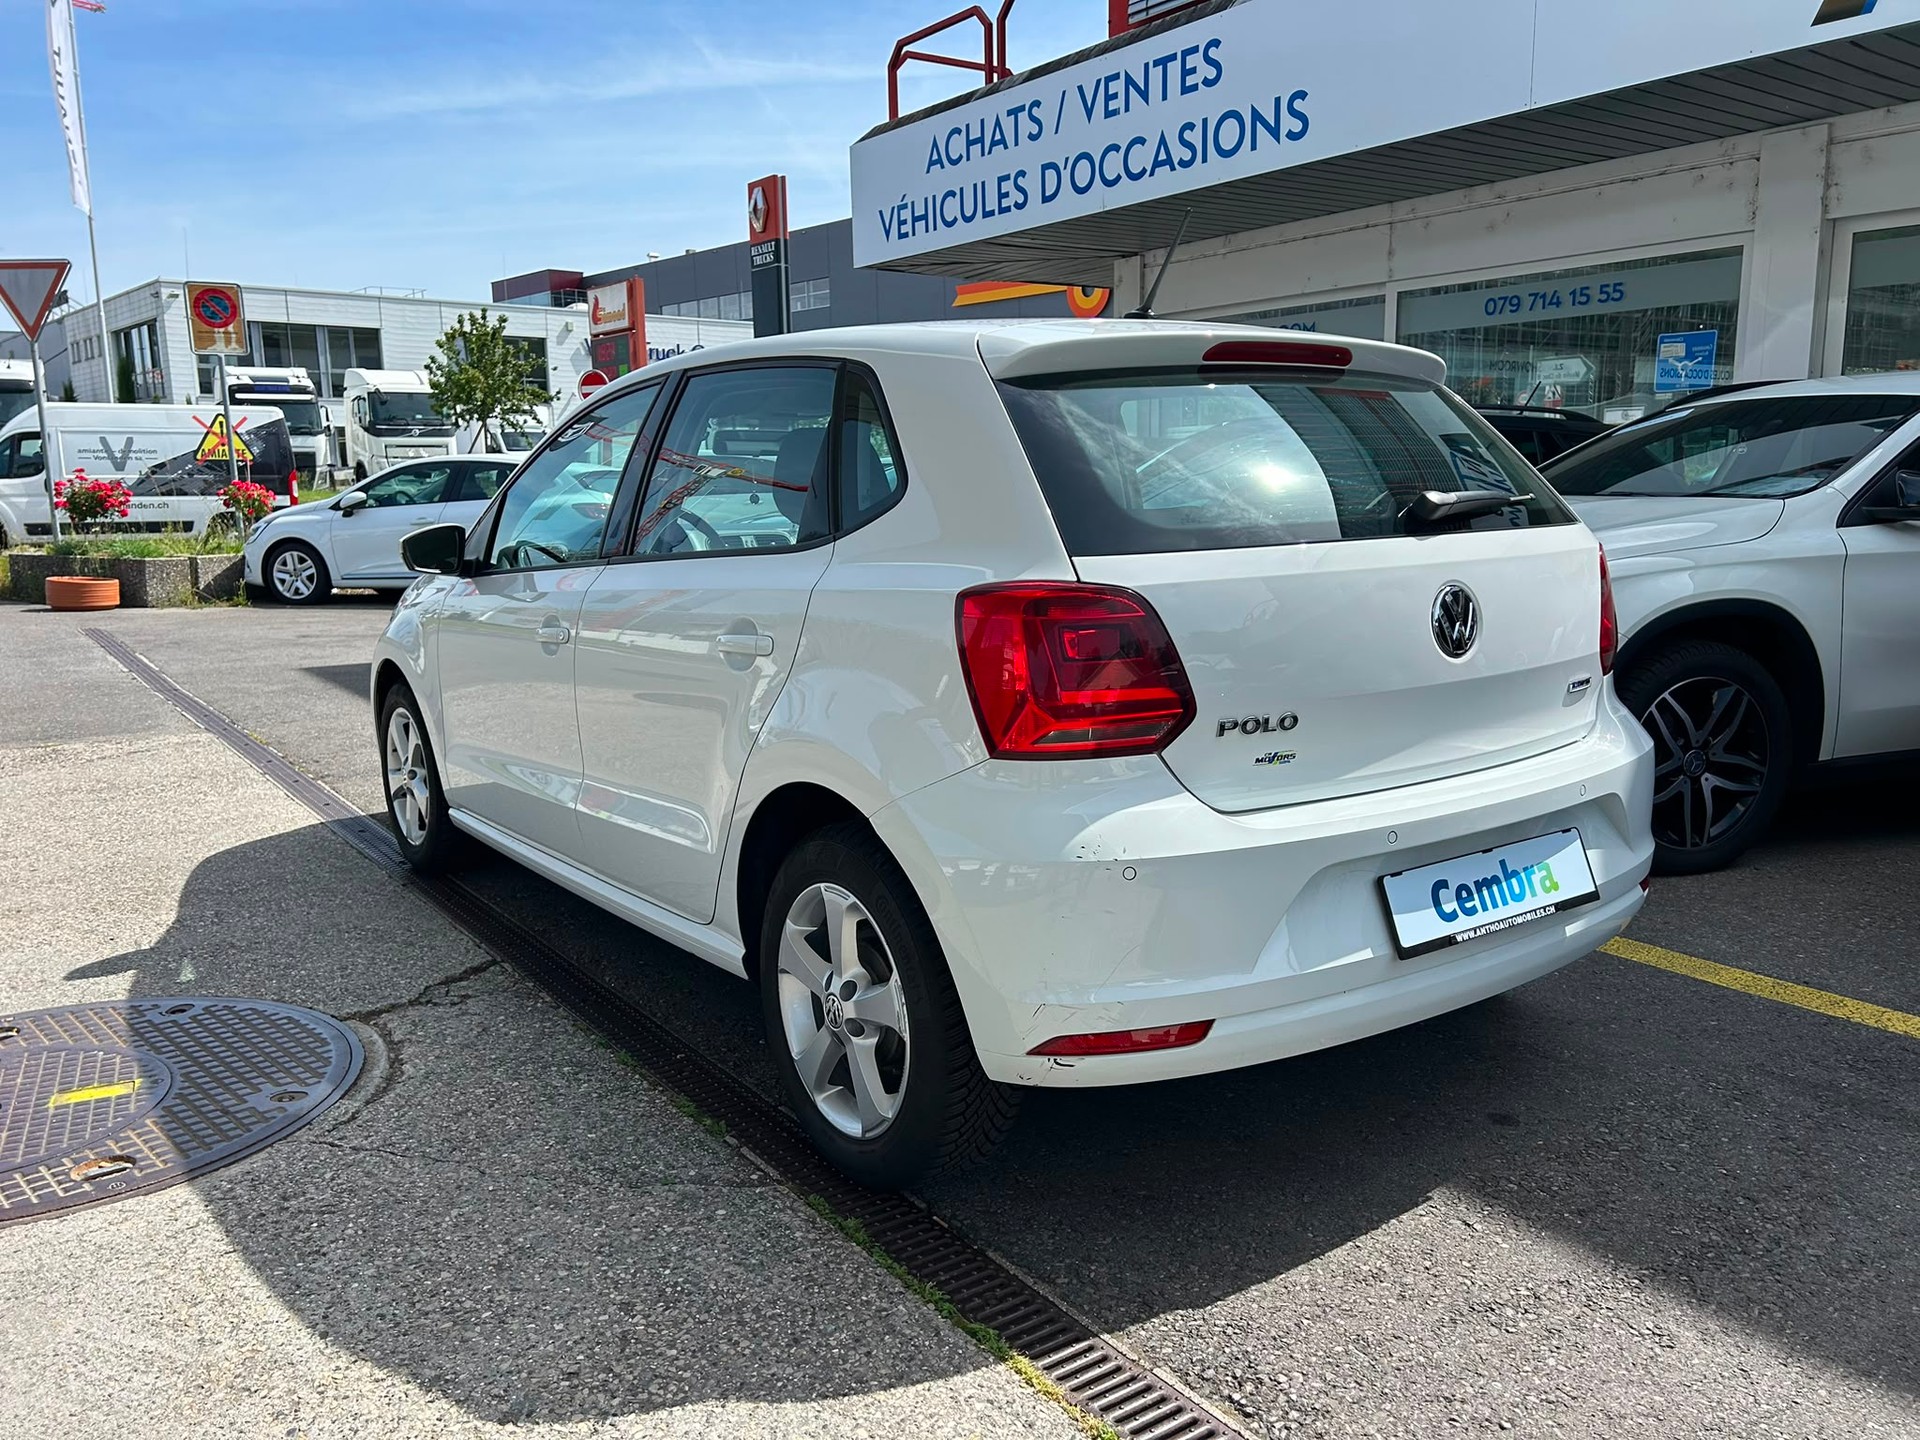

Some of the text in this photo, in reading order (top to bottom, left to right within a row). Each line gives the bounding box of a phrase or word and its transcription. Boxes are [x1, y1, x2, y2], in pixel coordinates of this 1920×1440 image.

[926, 38, 1223, 174] ACHATS / VENTES
[879, 89, 1310, 242] VÉHICULES D'OCCASIONS
[751, 241, 775, 256] RENAULT
[753, 252, 774, 266] TRUCKS
[1484, 282, 1624, 316] 079 714 15 55
[201, 448, 247, 458] AMIATE
[1216, 711, 1299, 737] POLO
[1431, 859, 1559, 923] Cembra
[1455, 905, 1556, 942] WWW.ANTHOAUTOMOBILES.CH
